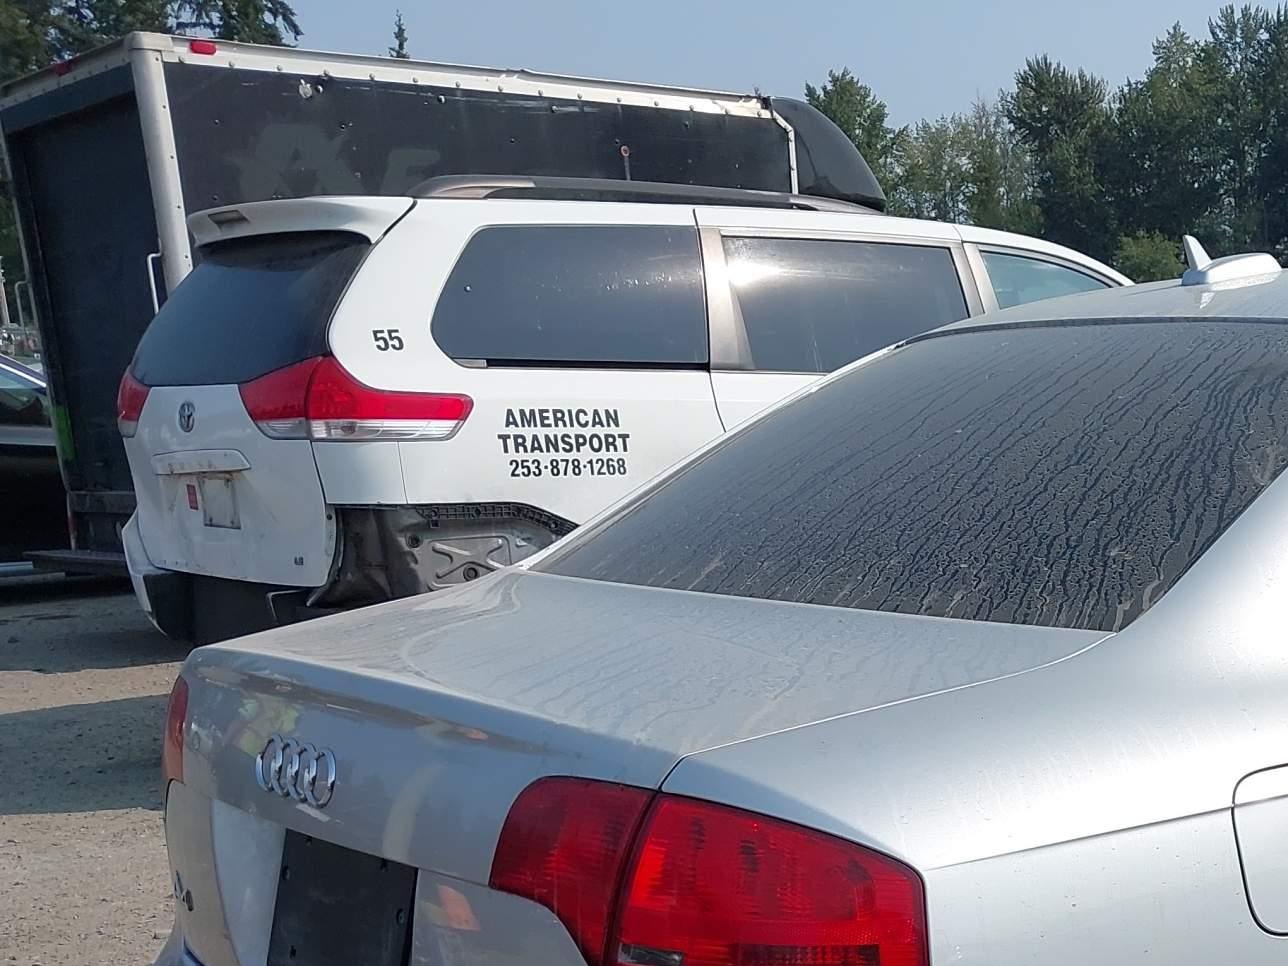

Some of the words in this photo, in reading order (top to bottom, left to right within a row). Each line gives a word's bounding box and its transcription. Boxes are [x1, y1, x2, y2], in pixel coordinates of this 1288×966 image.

[373, 329, 404, 351] 55
[504, 408, 620, 428] AMERICAN
[497, 433, 630, 454] TRANSPORT
